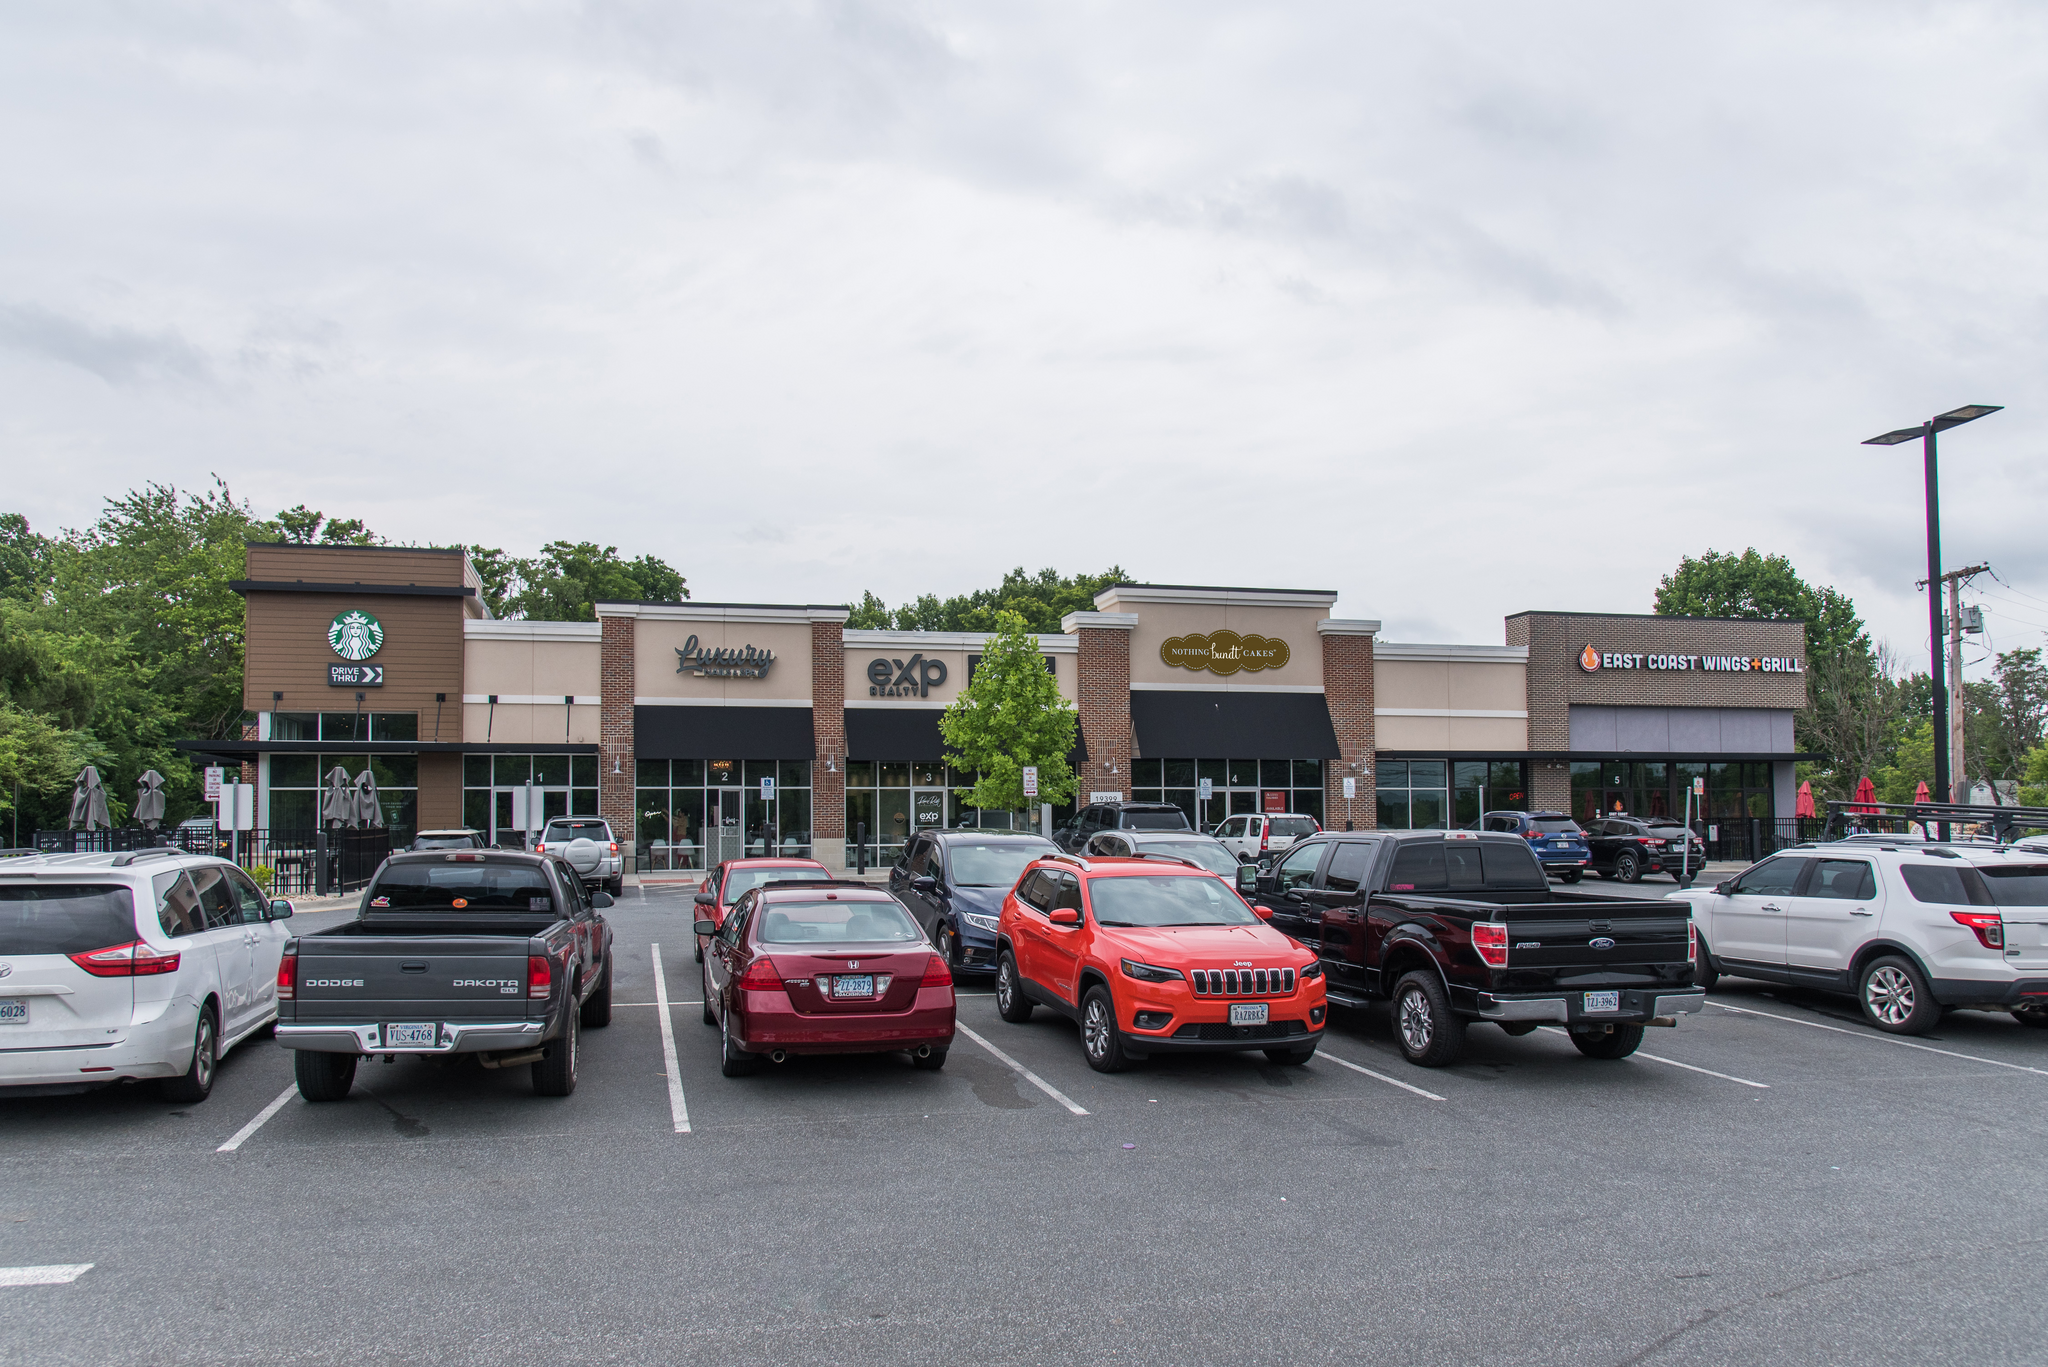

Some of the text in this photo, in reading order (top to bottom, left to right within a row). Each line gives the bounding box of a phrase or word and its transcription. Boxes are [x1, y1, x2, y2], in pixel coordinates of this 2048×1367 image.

[1171, 648, 1209, 656] NOTHING
[1210, 642, 1243, 659] bundt
[675, 634, 777, 678] Luxury
[1602, 653, 1643, 669] EAST
[1647, 654, 1698, 670] COAST
[331, 666, 359, 675] DRIVE
[703, 668, 731, 676] NAILS
[740, 668, 757, 676] SPA
[331, 674, 358, 682] THRU
[869, 685, 919, 696] REALTY
[537, 772, 543, 782] 1
[721, 772, 728, 781] 2
[926, 772, 932, 781] 3
[1231, 774, 1238, 783] 4
[1614, 775, 1620, 784] 5
[1509, 792, 1524, 800] OPEN
[306, 979, 364, 987] DODGE
[453, 979, 518, 987] DAKOTA
[1586, 997, 1617, 1006] TZJ-3962
[0, 1005, 26, 1018] 6028
[390, 1029, 433, 1041] VUS-4768
